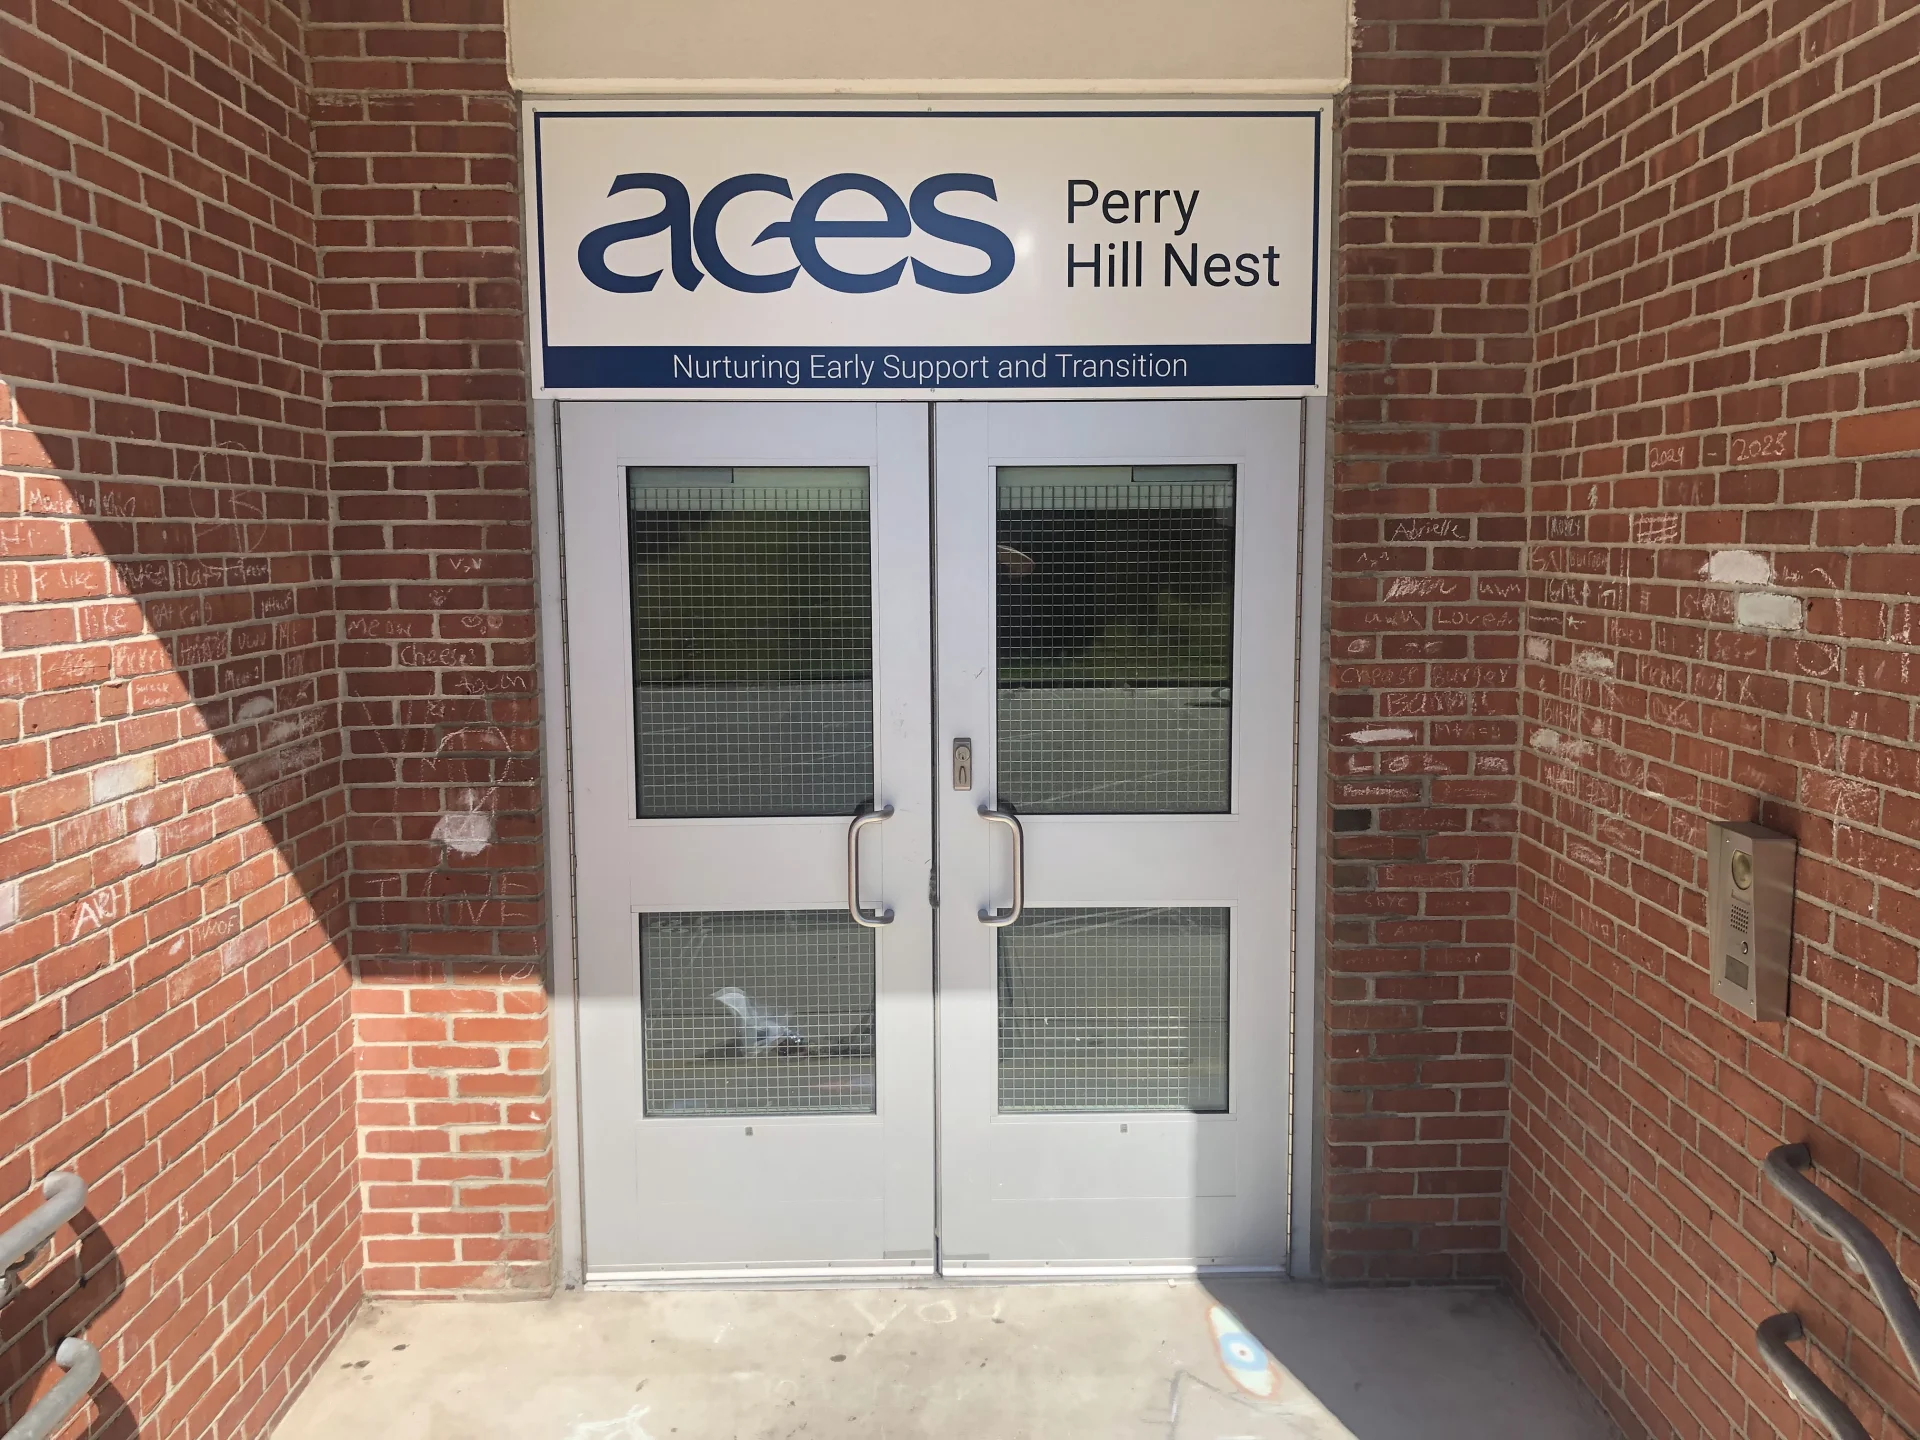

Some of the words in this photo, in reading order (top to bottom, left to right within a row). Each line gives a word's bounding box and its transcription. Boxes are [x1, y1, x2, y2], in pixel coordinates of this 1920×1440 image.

[1068, 180, 1199, 237] Perry
[578, 173, 1016, 294] aces
[1068, 241, 1143, 288] Hill
[1165, 243, 1281, 288] Nest
[673, 354, 800, 385] Nurturing
[811, 354, 875, 385] Early
[883, 354, 990, 385] Support
[998, 353, 1046, 379] and
[1054, 353, 1187, 379] Transition
[1649, 446, 1685, 468] 2024
